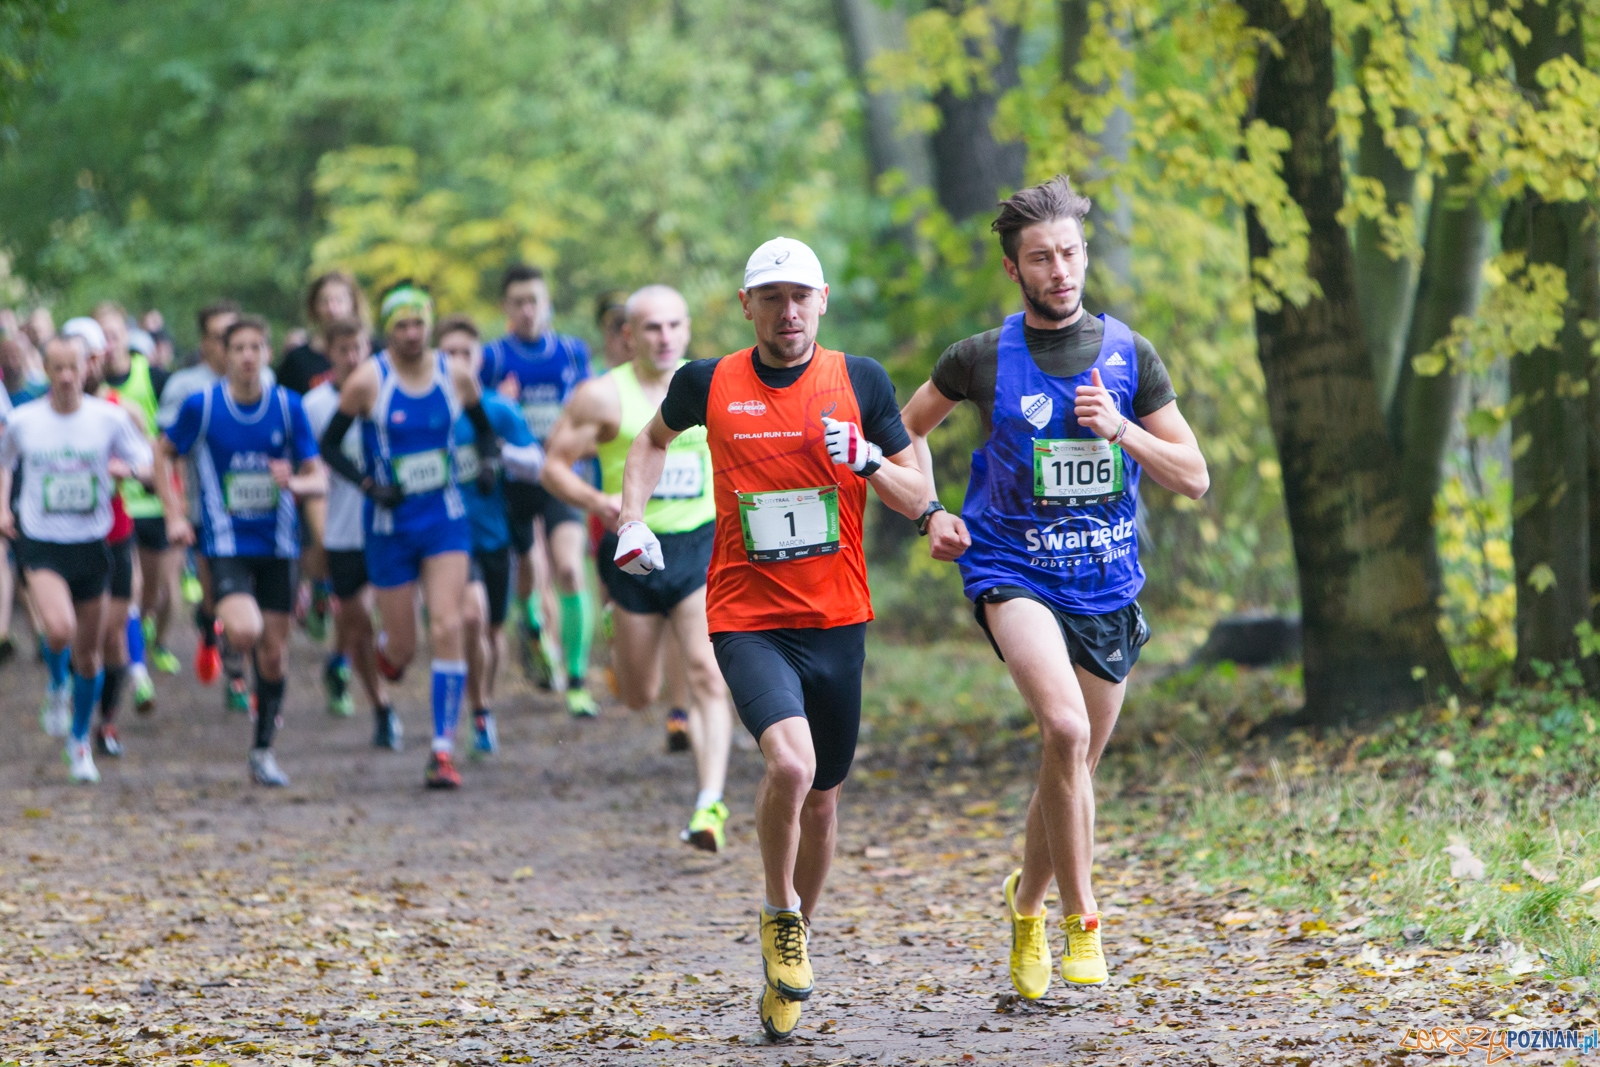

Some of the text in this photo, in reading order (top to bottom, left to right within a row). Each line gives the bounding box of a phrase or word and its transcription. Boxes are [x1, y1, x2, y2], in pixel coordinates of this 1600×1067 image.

[1025, 396, 1048, 416] UNIA
[1051, 459, 1111, 486] 1106
[1058, 486, 1106, 496] SZYMONSPEED
[784, 511, 796, 537] 1
[778, 539, 806, 548] MARCIN
[1025, 517, 1133, 552] Swarzędz
[1030, 558, 1081, 568] Dobrze
